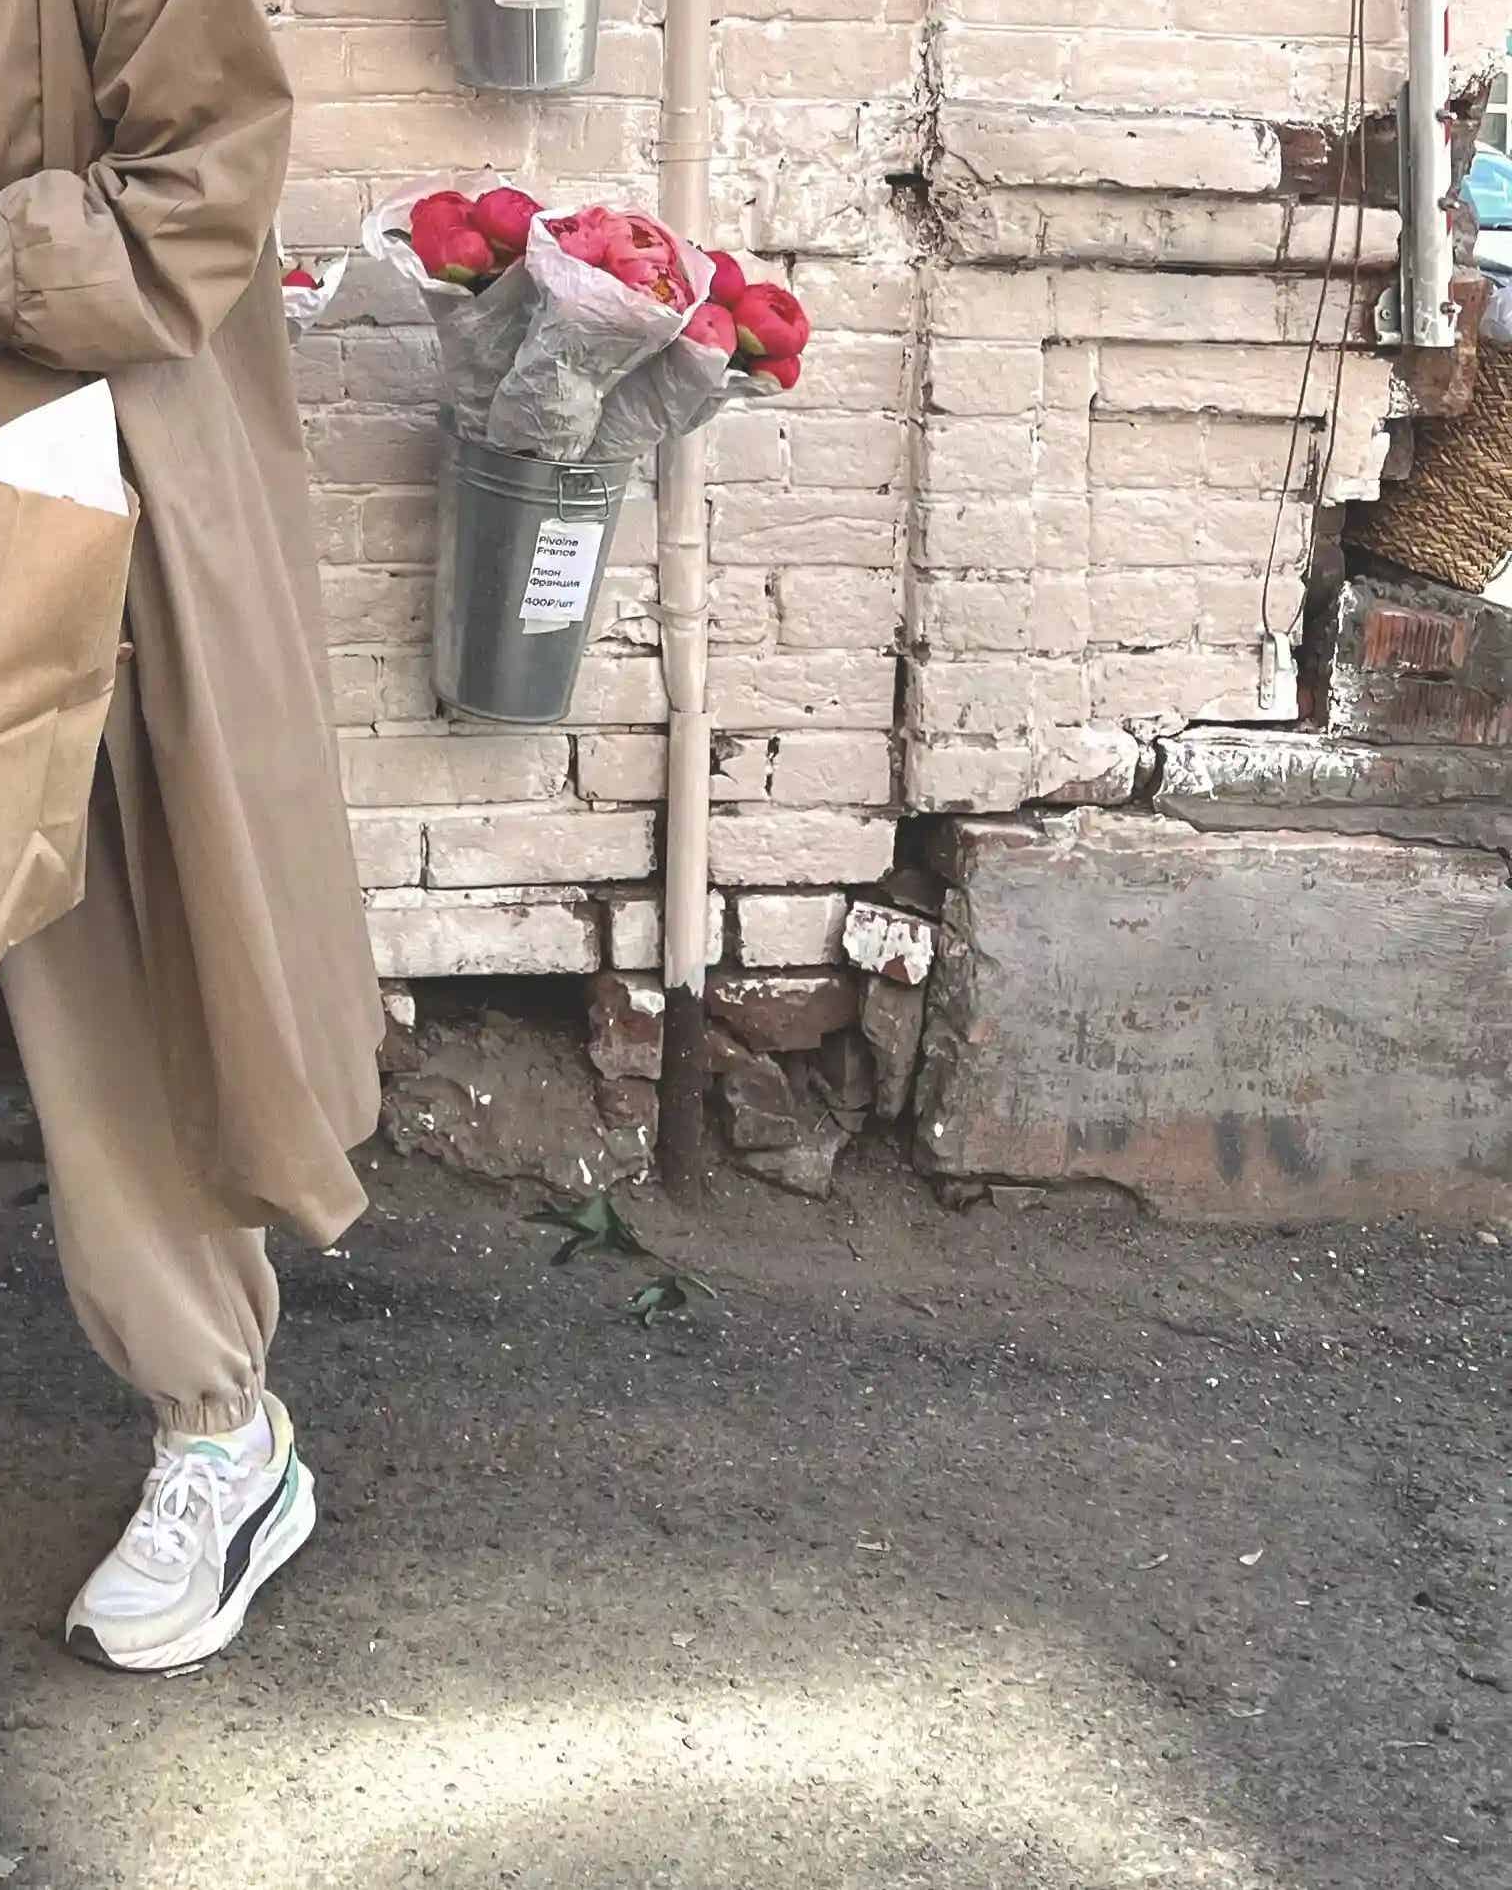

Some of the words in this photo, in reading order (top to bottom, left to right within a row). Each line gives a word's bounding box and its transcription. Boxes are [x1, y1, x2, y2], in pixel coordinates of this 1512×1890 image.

[538, 536, 579, 547] Pivoine
[536, 546, 577, 557] France
[533, 567, 561, 576] Пион
[529, 577, 580, 588] Франция
